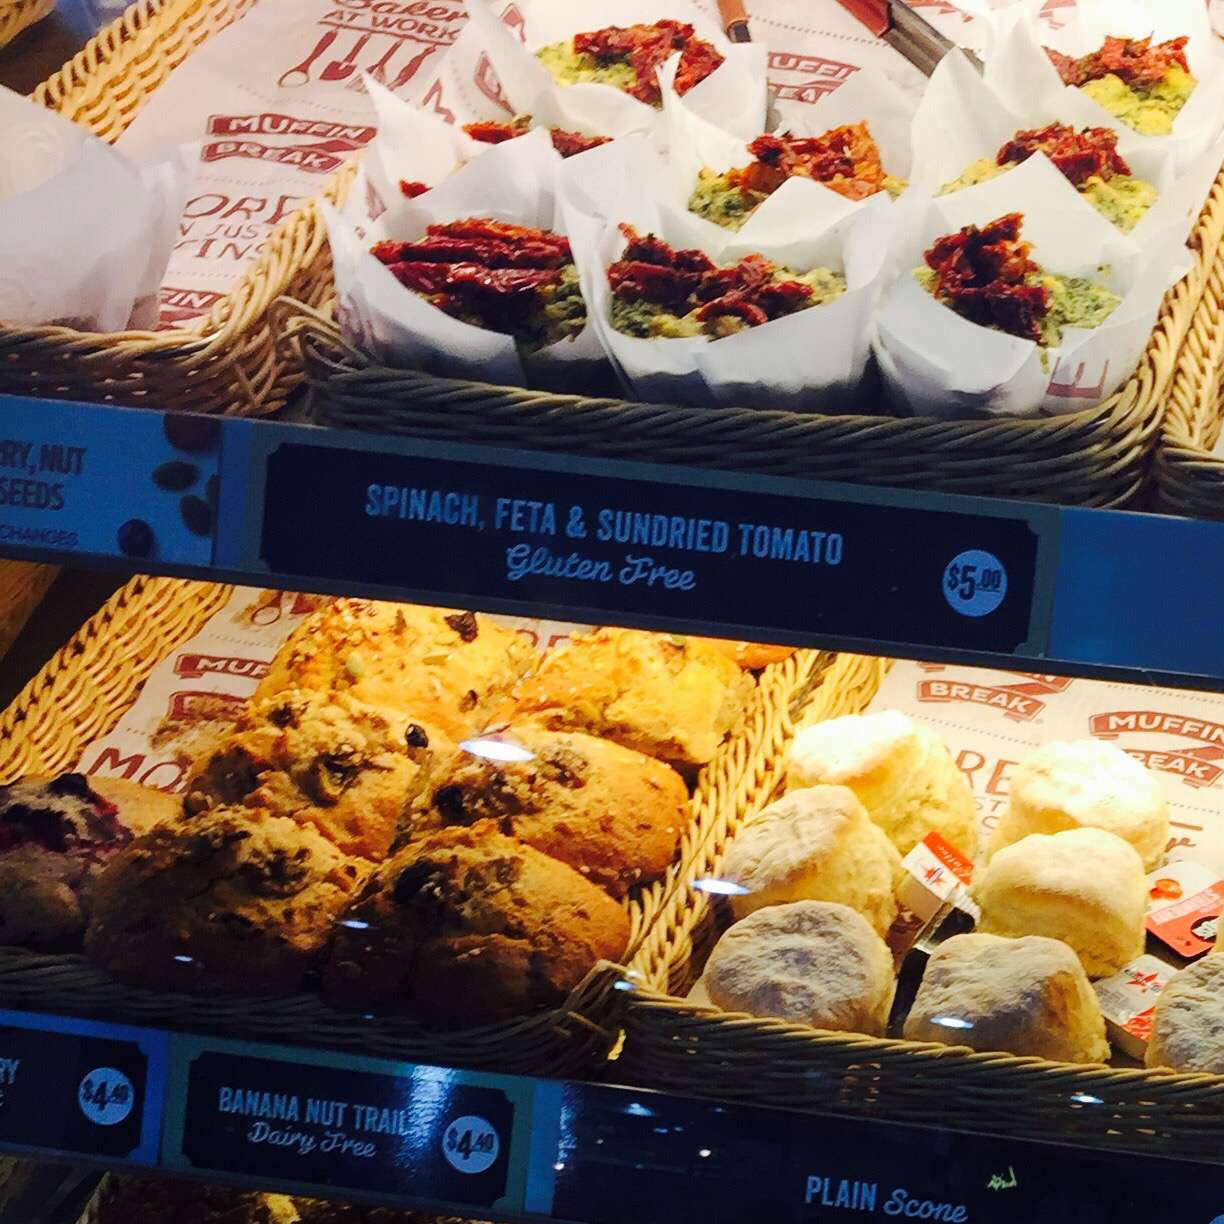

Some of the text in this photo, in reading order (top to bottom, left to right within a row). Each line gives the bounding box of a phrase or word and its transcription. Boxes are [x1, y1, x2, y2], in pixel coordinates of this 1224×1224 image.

[323, 10, 461, 41] AT WORK
[768, 54, 850, 80] UFFI
[229, 115, 366, 140] MUFFIN
[215, 142, 331, 169] BREAK
[183, 193, 312, 225] ORE
[205, 222, 274, 240] JUS
[40, 443, 87, 476] NUT
[366, 483, 844, 567] SPINACH, FETA & SUNDRIED TOMATO
[506, 543, 697, 591] Gluten Free
[196, 658, 270, 677] MUF
[929, 682, 1033, 714] BREAK
[87, 747, 192, 794] MO
[1130, 751, 1211, 779] REAK
[218, 1086, 300, 1123] BANANA
[305, 1098, 348, 1128] NUT
[248, 1121, 377, 1158] Dairy Free
[805, 1175, 969, 1223] PLAIN Scone
